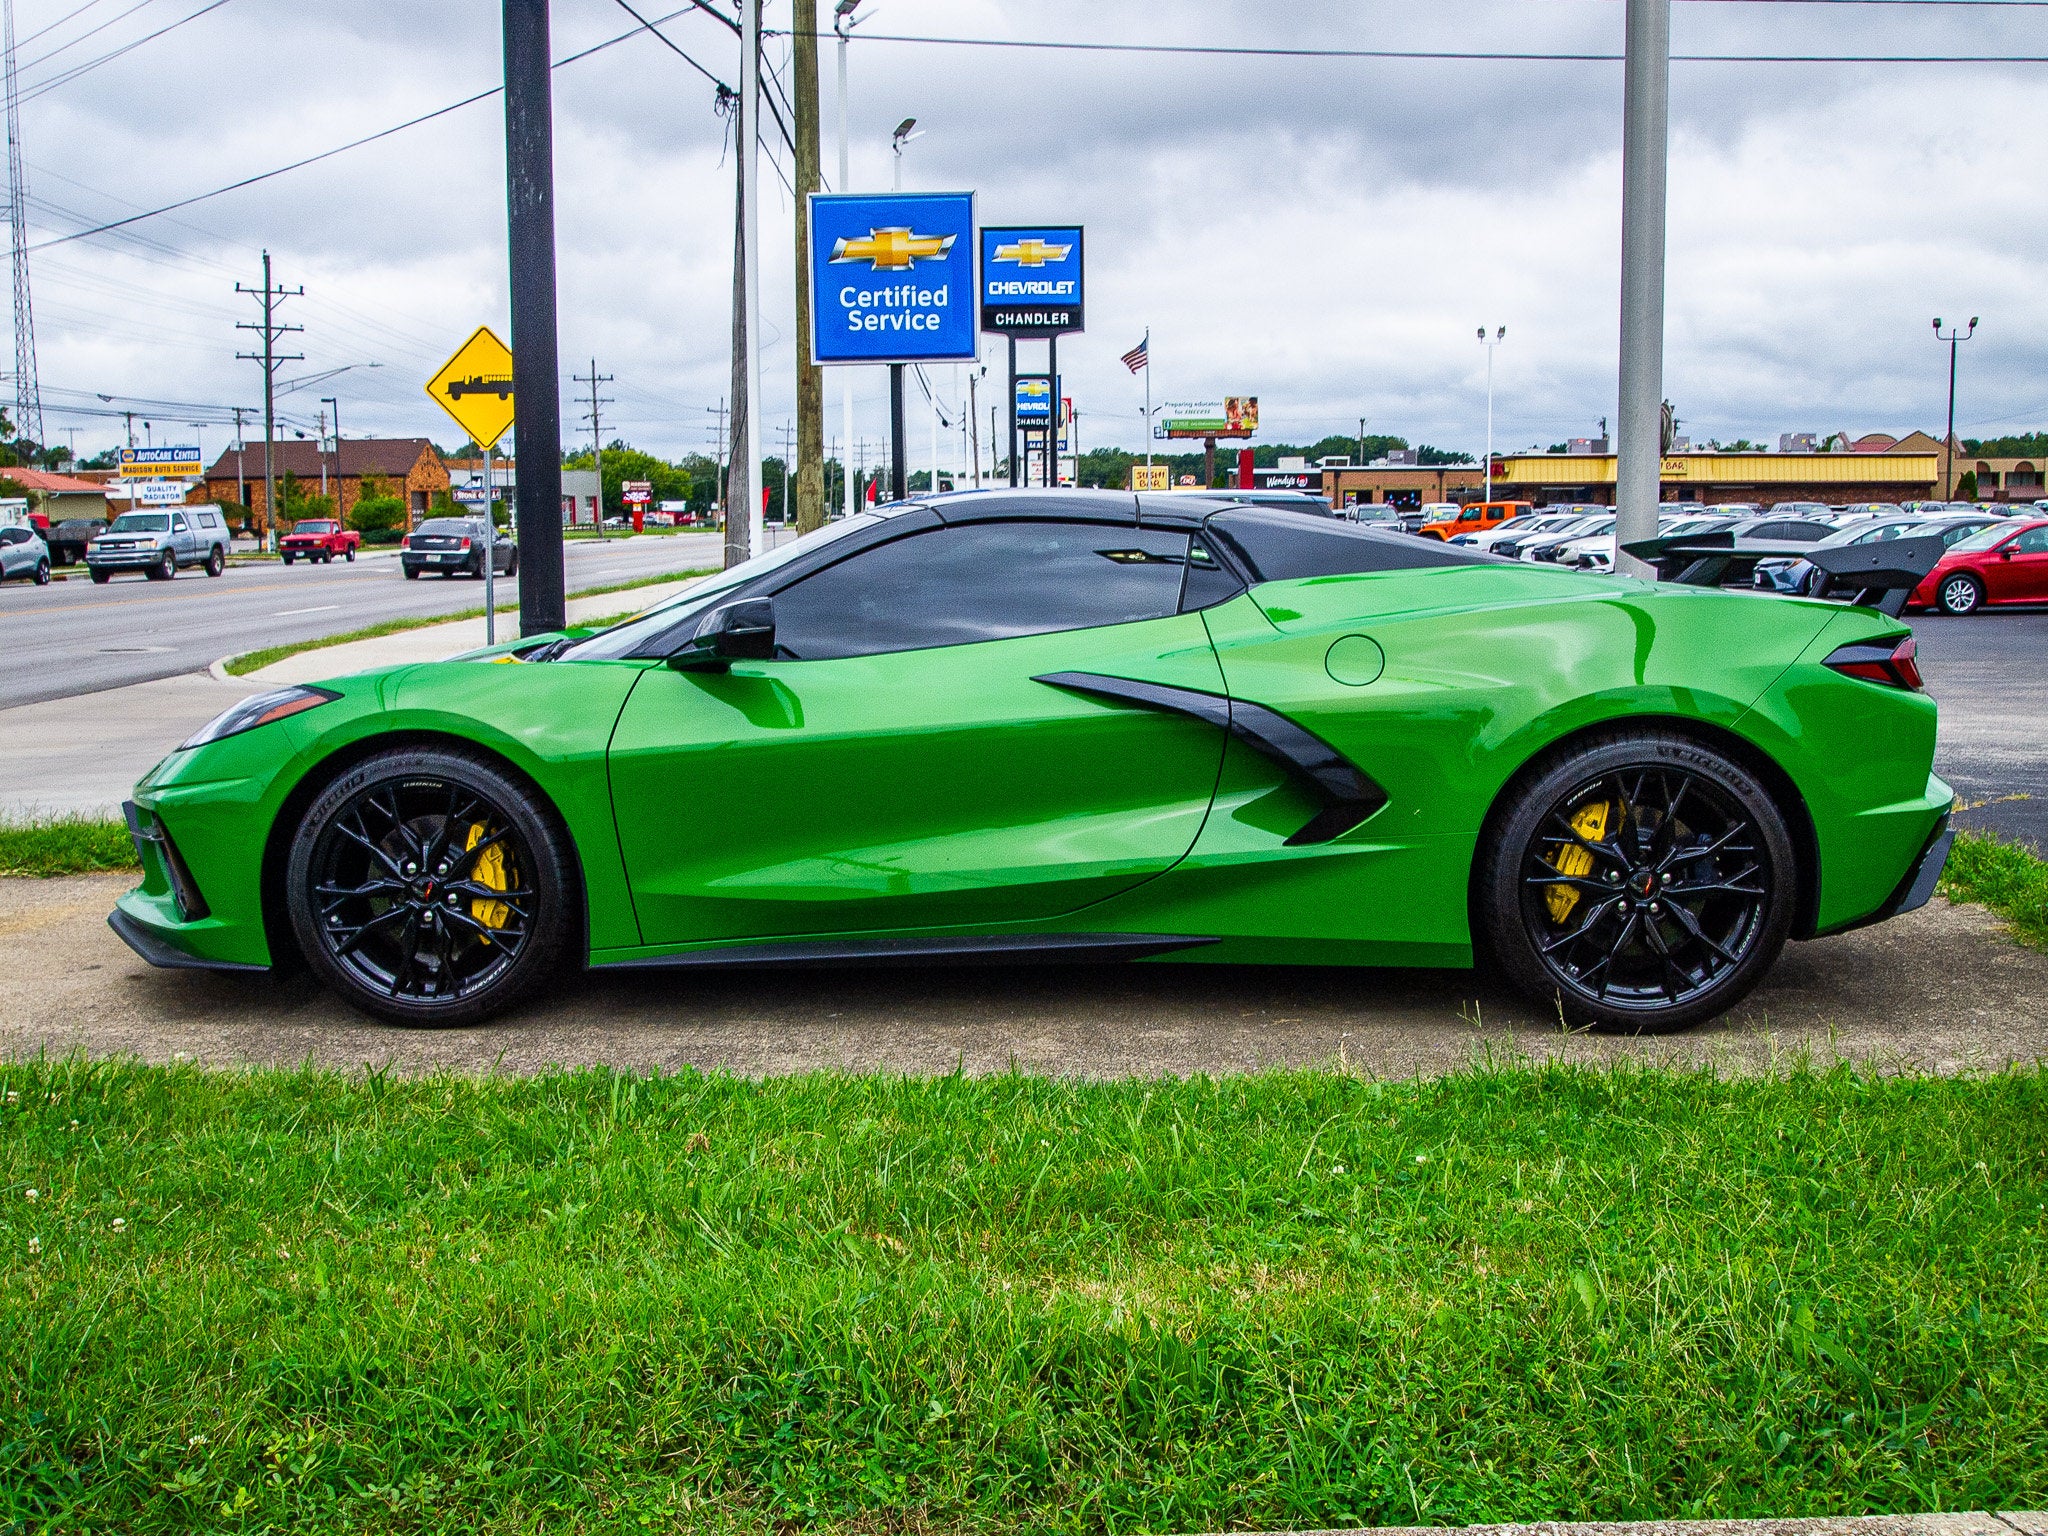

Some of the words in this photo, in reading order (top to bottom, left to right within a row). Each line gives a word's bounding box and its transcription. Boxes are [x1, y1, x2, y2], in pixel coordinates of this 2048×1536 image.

[989, 281, 1075, 295] CHEVROLET
[839, 284, 948, 308] Certified
[848, 309, 941, 331] Service
[995, 312, 1069, 325] CHANDLER
[1266, 474, 1296, 488] Wendy's
